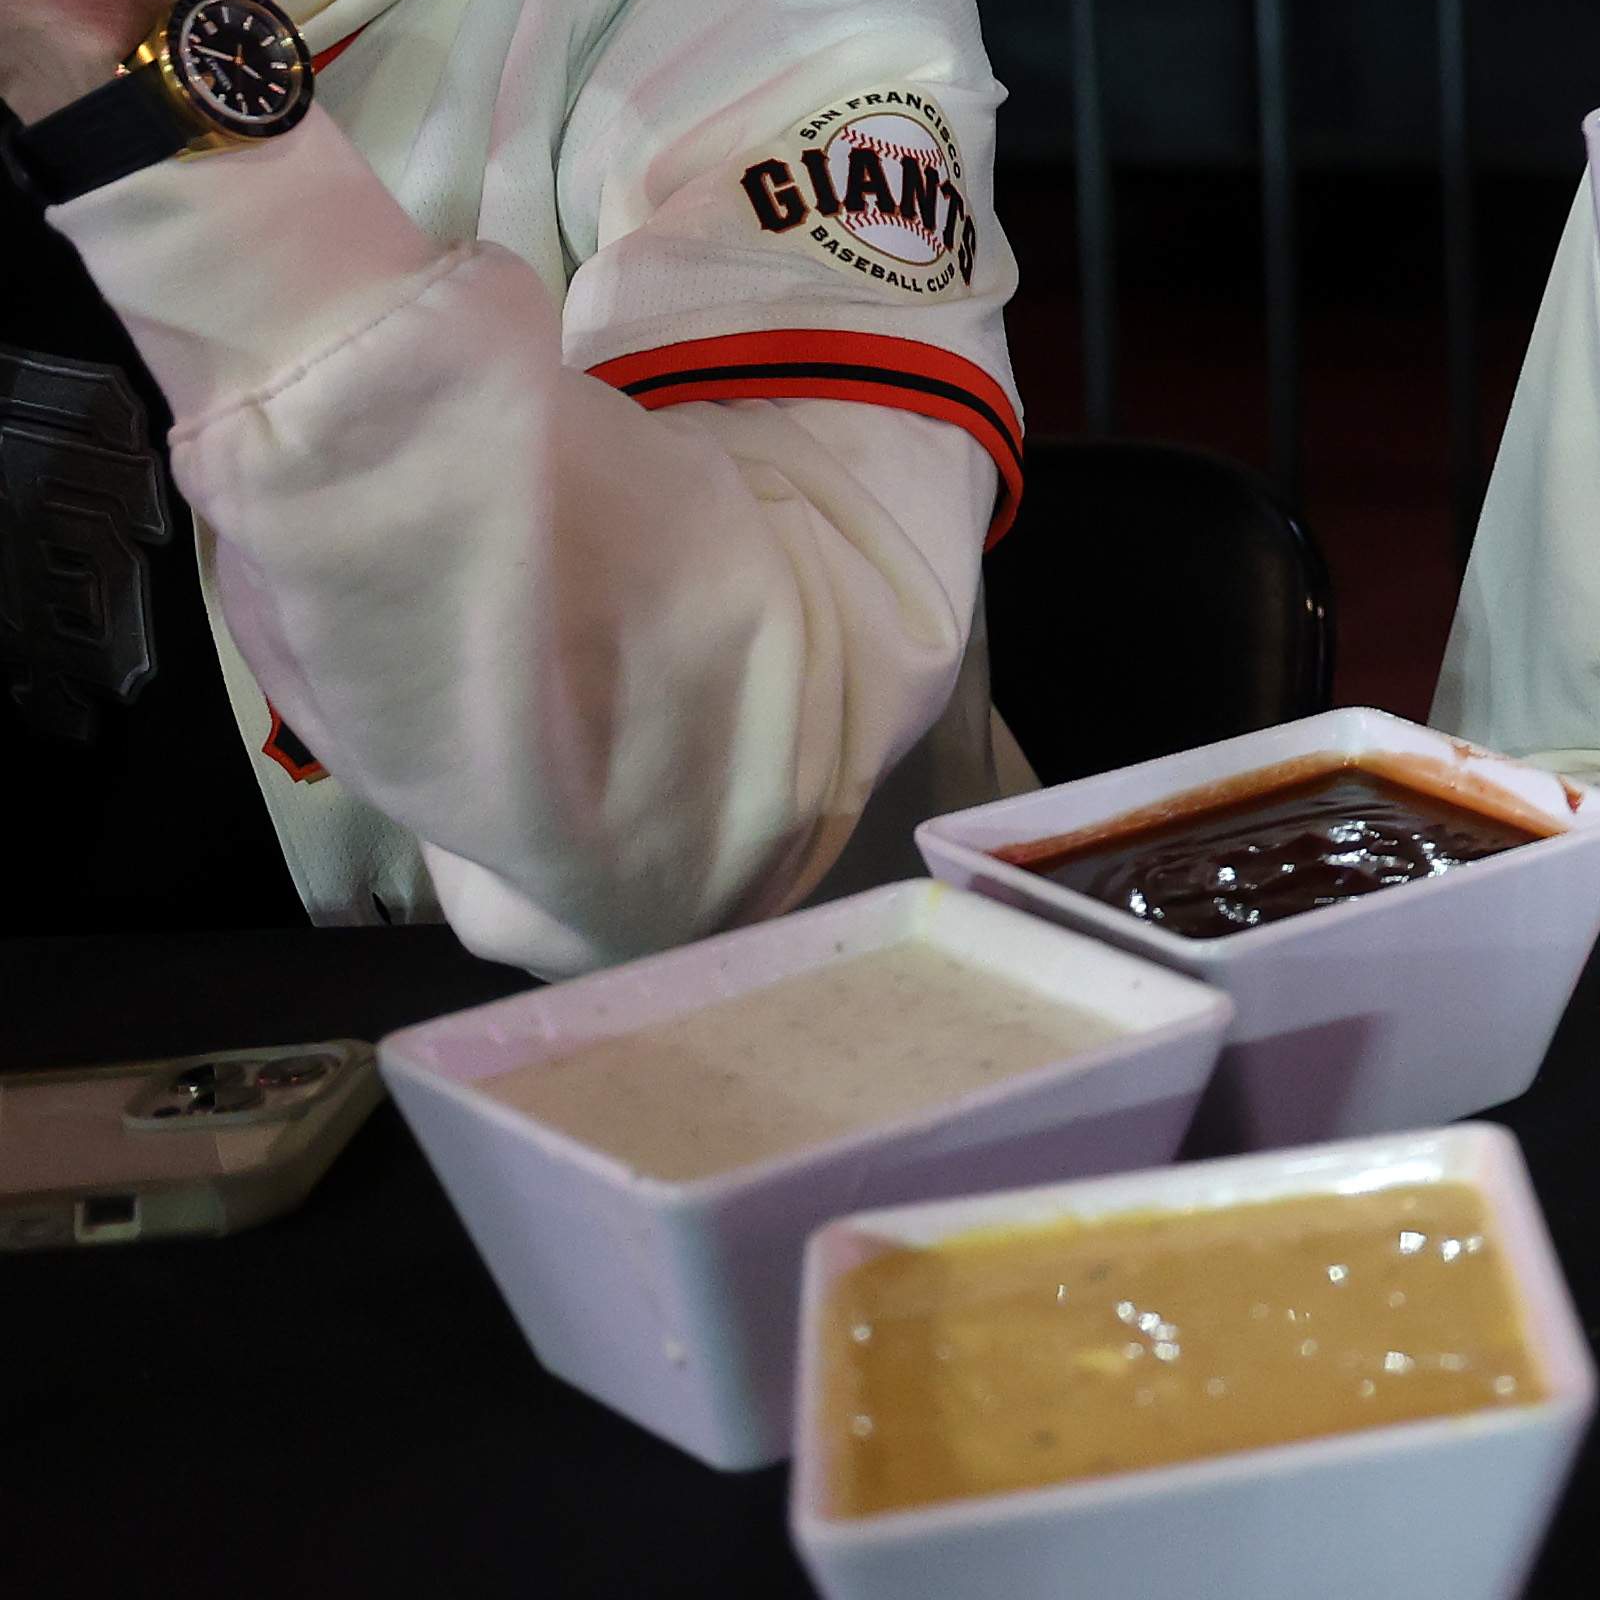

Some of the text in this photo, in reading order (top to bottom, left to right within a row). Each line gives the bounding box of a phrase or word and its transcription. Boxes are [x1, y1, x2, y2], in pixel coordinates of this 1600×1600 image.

[799, 91, 961, 181] SAN FRANCISCO
[740, 146, 978, 289] GIANTS
[809, 224, 956, 295] BASEBALL CLUB
